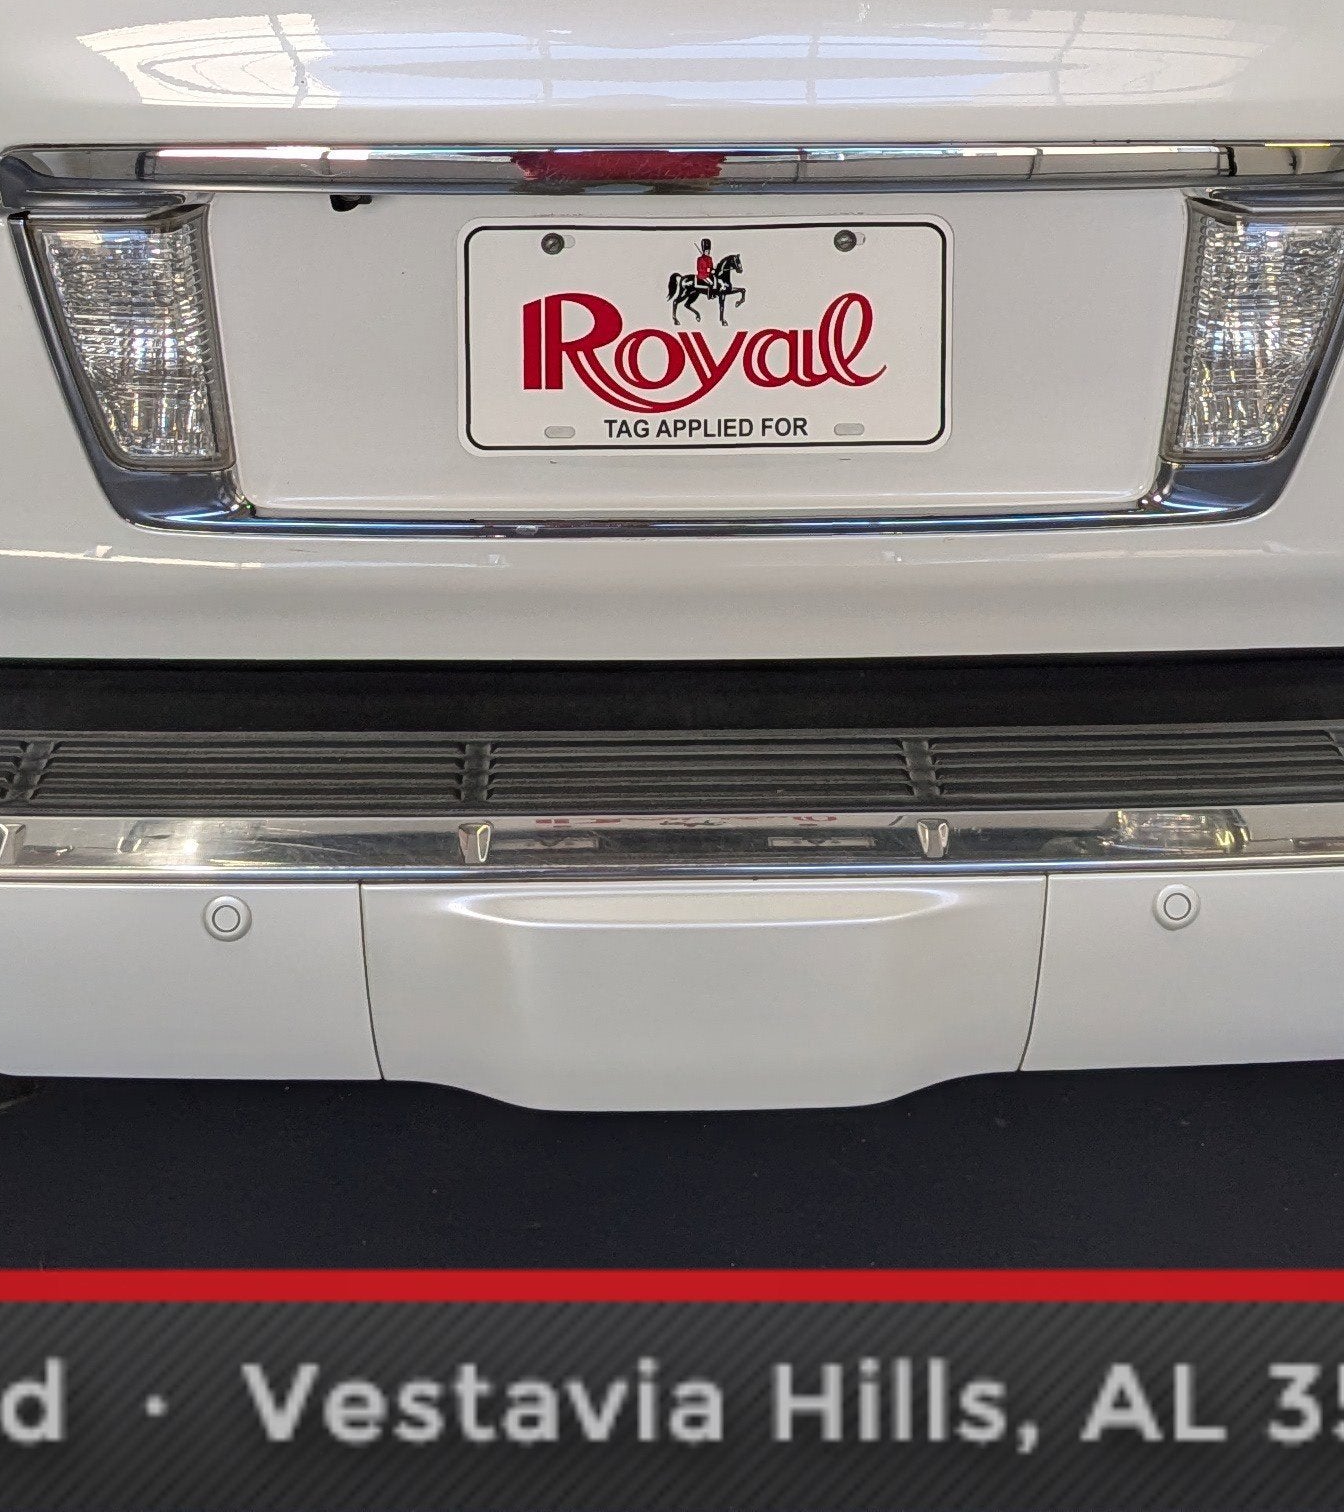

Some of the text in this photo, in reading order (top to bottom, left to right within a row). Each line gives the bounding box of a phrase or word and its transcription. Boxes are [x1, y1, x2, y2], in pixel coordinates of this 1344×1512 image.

[522, 292, 887, 414] Royal
[604, 417, 808, 439] TAG APPLIED FOR
